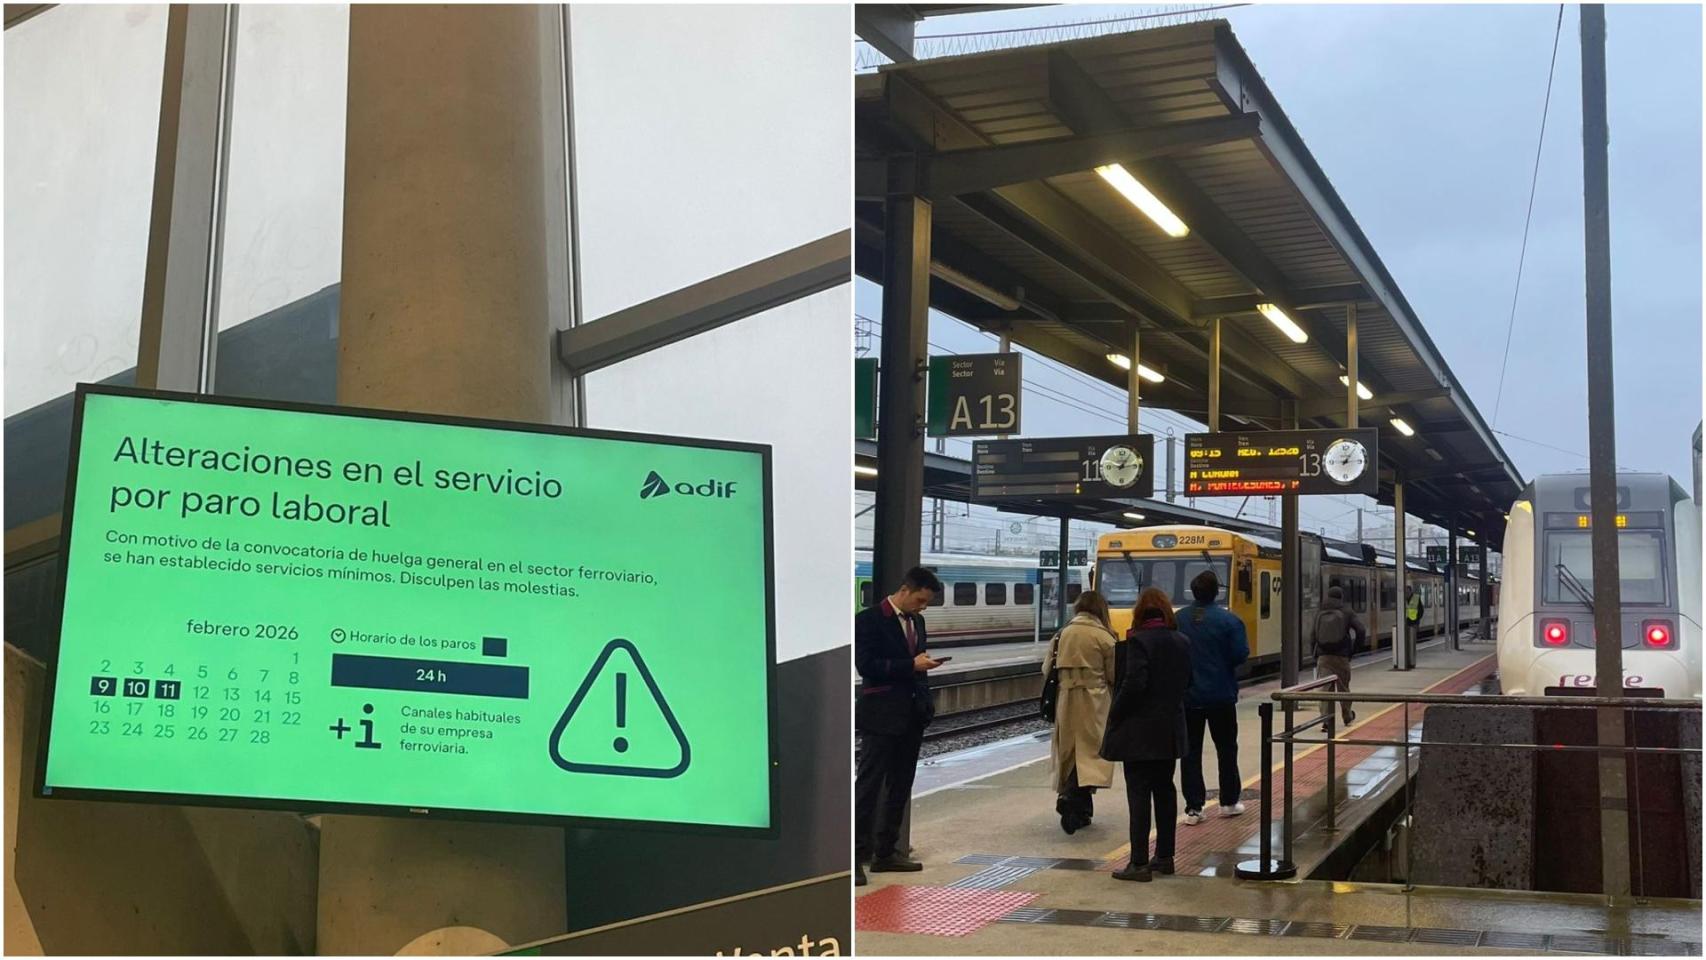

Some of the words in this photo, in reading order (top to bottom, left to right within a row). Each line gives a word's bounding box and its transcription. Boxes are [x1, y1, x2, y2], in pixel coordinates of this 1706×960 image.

[952, 370, 974, 378] Sector
[951, 396, 973, 430] A
[979, 393, 1015, 429] 13
[113, 435, 333, 480] Alteraciones
[343, 462, 383, 485] en
[393, 460, 424, 487] el
[434, 468, 563, 499] servicio
[1082, 459, 1102, 482] 11
[1299, 453, 1321, 477] 13
[674, 479, 738, 499] adif
[110, 485, 171, 513] por
[181, 491, 261, 519] paro
[272, 491, 391, 527] laboral
[1179, 535, 1205, 545] 228M
[105, 529, 138, 545] Con
[142, 533, 198, 549] motivo
[202, 536, 221, 551] de
[226, 538, 240, 552] la
[243, 541, 345, 561] convocatoria
[348, 547, 368, 562] de
[371, 550, 423, 569] huelga
[426, 555, 483, 573] general
[487, 561, 505, 573] en
[509, 560, 523, 574] el
[527, 562, 574, 578] sector
[578, 564, 658, 586] ferroviario,
[104, 552, 122, 564] se
[125, 551, 155, 566] han
[159, 554, 252, 573] establecido
[255, 562, 324, 578] servicios
[327, 564, 396, 584] mínimos.
[400, 571, 474, 591] Disculpen
[478, 575, 500, 591] las
[504, 578, 579, 598] molestias.
[186, 619, 250, 637] febrero
[255, 624, 299, 640] 2026
[350, 630, 396, 644] Horario
[400, 635, 416, 646] de
[419, 636, 437, 647] los
[441, 638, 476, 650] paros
[293, 652, 298, 664] 1
[100, 659, 111, 672] 2
[133, 662, 144, 674] 3
[164, 664, 174, 676] 4
[197, 666, 207, 678] 5
[228, 668, 238, 680] 6
[259, 670, 269, 682] 7
[289, 672, 299, 684] 8
[416, 669, 435, 681] 24
[438, 669, 446, 682] h
[98, 680, 108, 693] 9
[127, 681, 146, 695] 10
[161, 683, 175, 697] 11
[193, 687, 209, 699] 12
[224, 688, 240, 701] 13
[255, 690, 271, 703] 14
[285, 692, 301, 704] 15
[94, 701, 110, 714] 16
[127, 703, 143, 716] 17
[159, 705, 174, 718] 18
[192, 707, 208, 719] 19
[220, 708, 240, 721] 20
[254, 710, 270, 723] 21
[282, 712, 301, 725] 22
[401, 705, 452, 720] Canales
[456, 709, 521, 724] habituales
[90, 721, 110, 734] 23
[122, 723, 143, 736] 24
[154, 725, 175, 738] 25
[188, 727, 208, 740] 26
[219, 729, 239, 742] 27
[250, 731, 270, 744] 28
[400, 723, 417, 734] de
[420, 725, 435, 735] su
[438, 727, 493, 739] empresa
[400, 739, 469, 754] ferroviaria.
